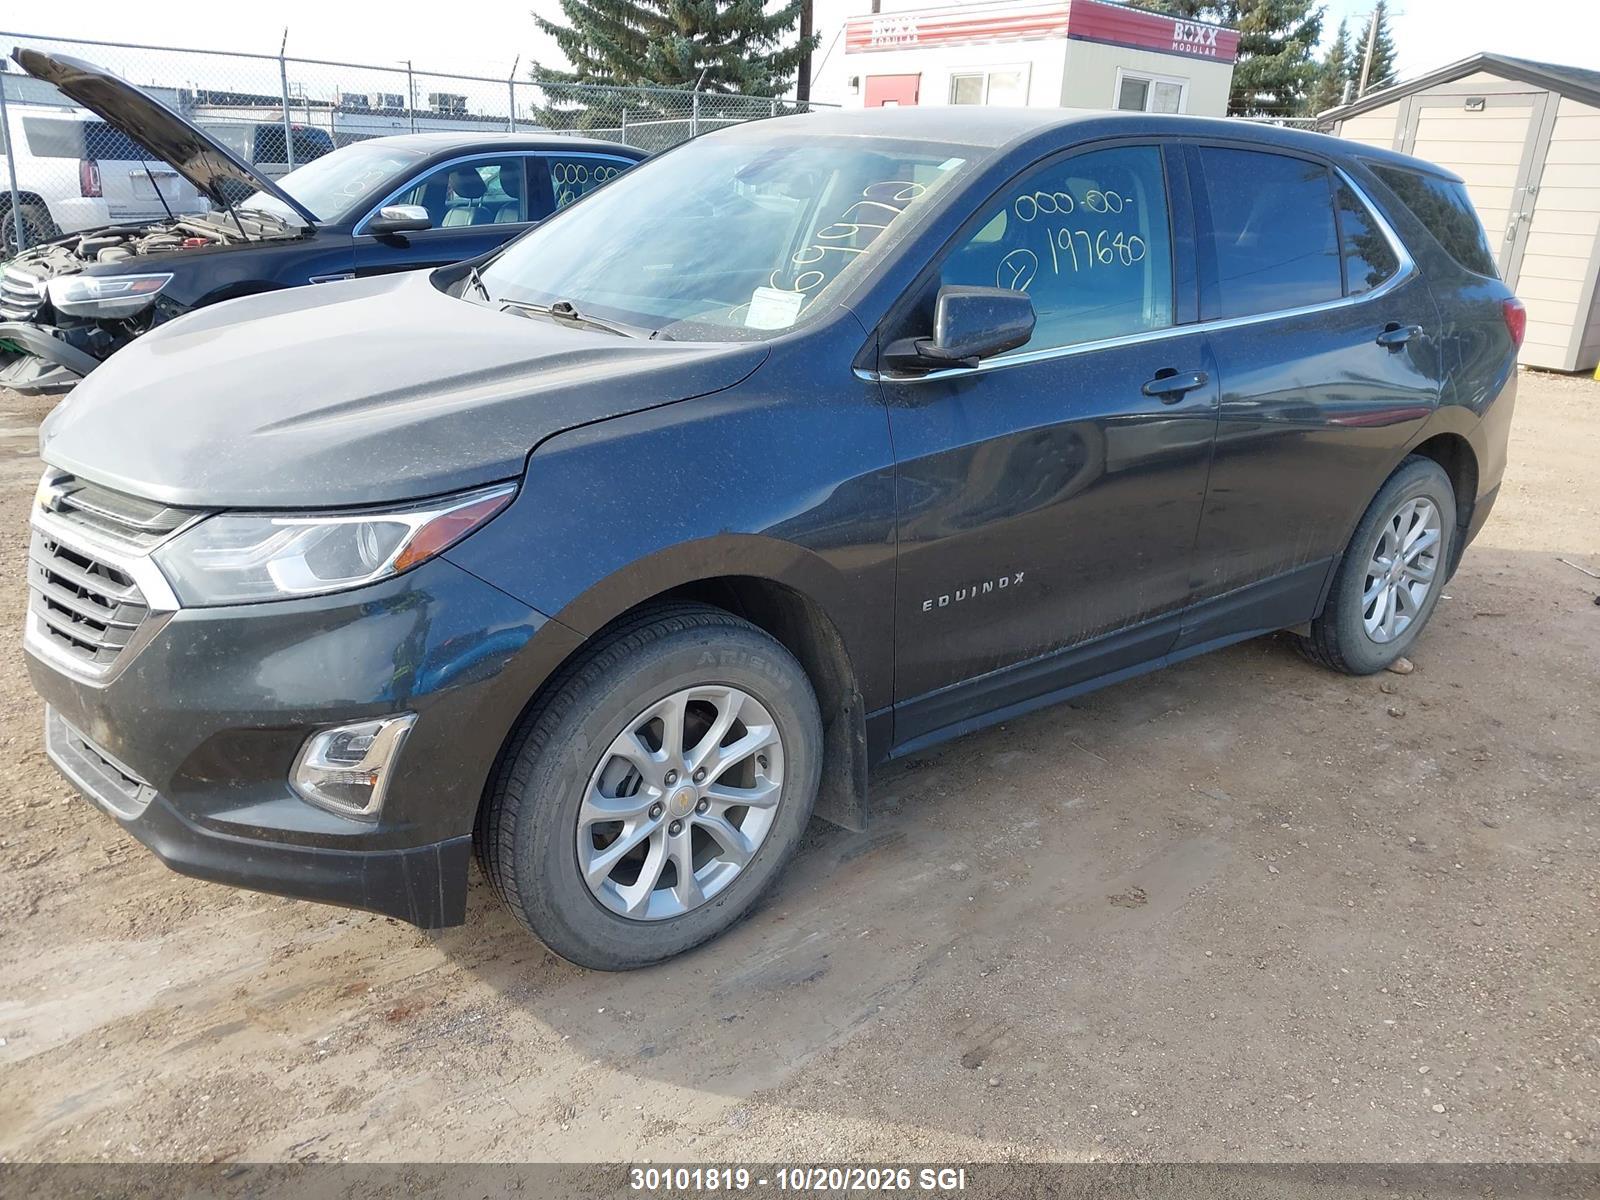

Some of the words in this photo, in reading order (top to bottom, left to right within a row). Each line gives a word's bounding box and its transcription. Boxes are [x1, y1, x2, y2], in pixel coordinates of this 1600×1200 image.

[1172, 42, 1217, 56] MODULAR
[1173, 22, 1218, 47] BOXX
[1047, 228, 1146, 275] 197680
[922, 571, 1026, 612] EQUINOX
